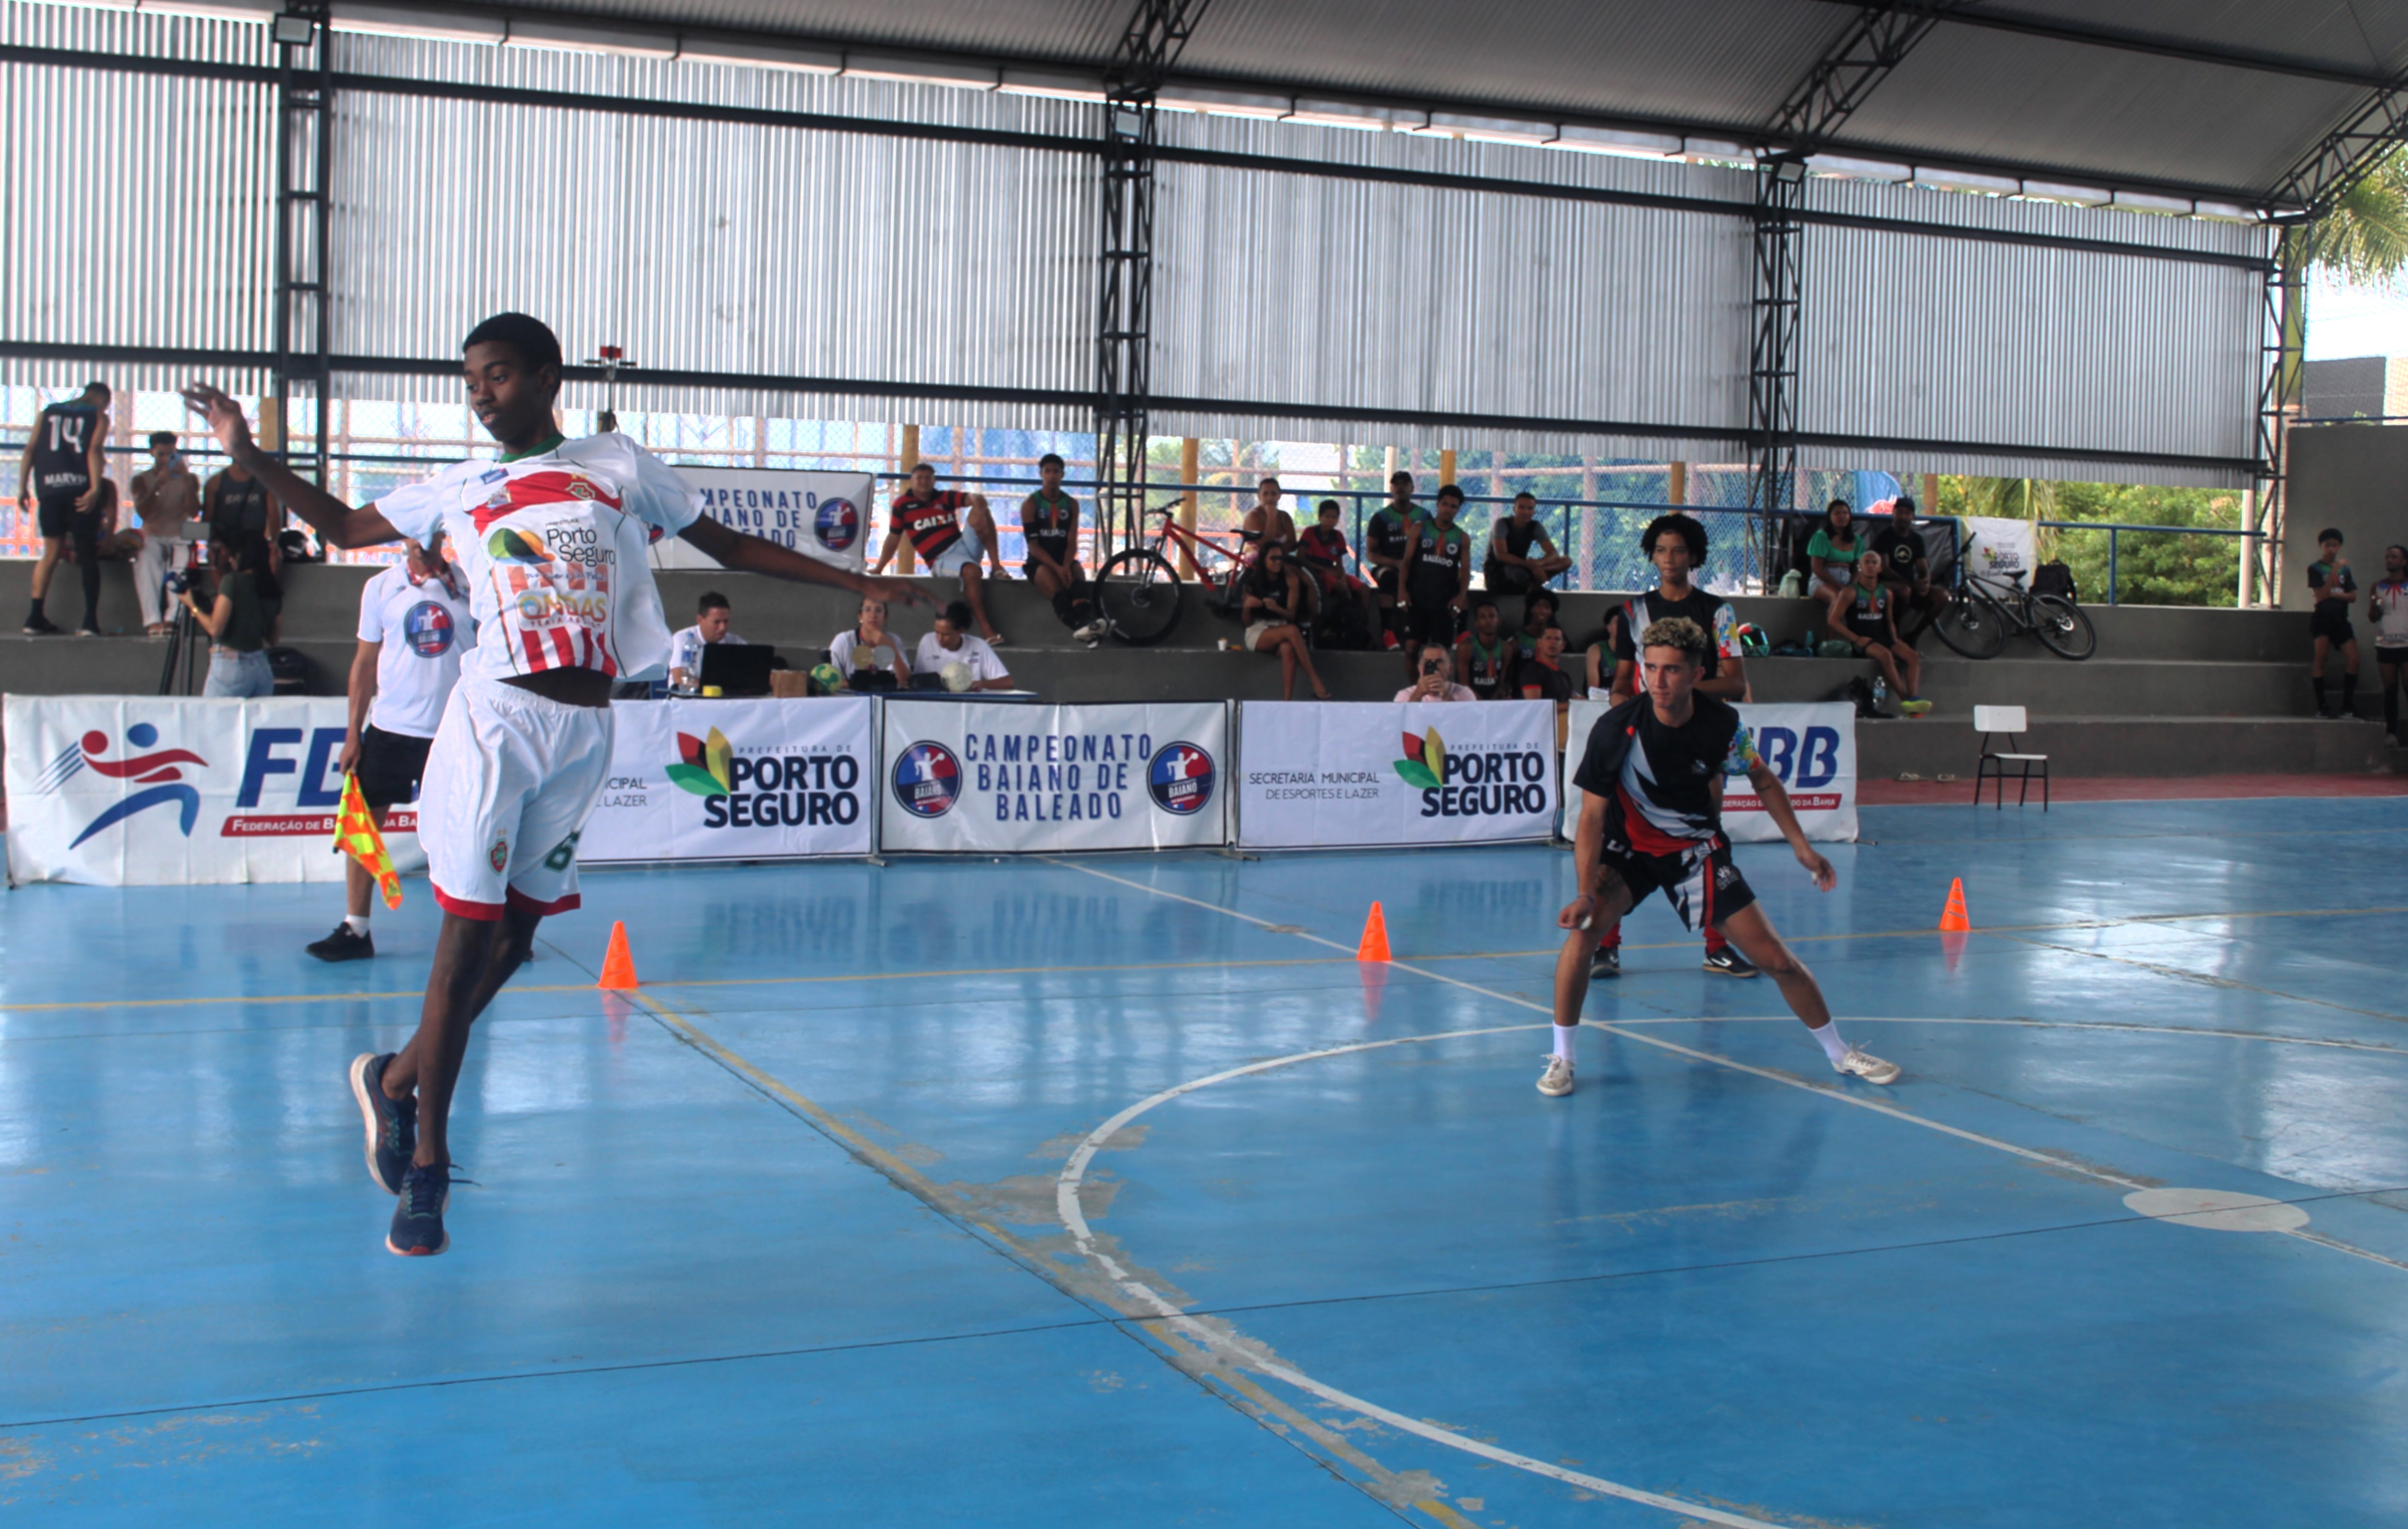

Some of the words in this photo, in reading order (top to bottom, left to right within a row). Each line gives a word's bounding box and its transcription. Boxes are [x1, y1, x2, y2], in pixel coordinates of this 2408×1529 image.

[48, 415, 84, 453] 14
[700, 488, 817, 509] MPEONATO
[711, 507, 763, 528] IANO
[777, 510, 801, 529] DE
[913, 513, 955, 531] CAIXA
[547, 527, 597, 547] Porto
[1422, 539, 1433, 548] 07
[559, 544, 616, 567] Seguro
[1422, 553, 1453, 567] BALEADO
[1989, 561, 2020, 569] SEGURO
[519, 593, 607, 623] ONDAS
[739, 745, 827, 755] PREFEITURA
[965, 734, 1151, 762] CAMPEONATO
[1451, 743, 1518, 751] PREFEITURA
[235, 728, 348, 808] FB
[729, 755, 859, 792] PORTO
[978, 763, 1081, 792] BAIANO
[1097, 762, 1128, 790] DE
[1443, 751, 1545, 785] PORTO
[605, 777, 647, 790] ICIPAL
[1249, 772, 1315, 785] SECRETARIA
[1321, 772, 1380, 784] MUNICIPAL
[604, 794, 648, 807] LAZER
[1168, 782, 1198, 799] BAIANO
[1266, 789, 1281, 800] DE
[1283, 788, 1335, 800] ESPORTES
[1337, 788, 1343, 799] E
[1345, 788, 1379, 799] LAZER
[1420, 783, 1547, 818] SEGURO
[704, 791, 860, 829] SEGURO
[996, 792, 1122, 821] BALEADO
[1723, 799, 1756, 808] DERAÇÃO
[1813, 796, 1836, 806] BAHIA
[232, 819, 303, 833] FEDERAÇÃO
[305, 821, 320, 830] DE
